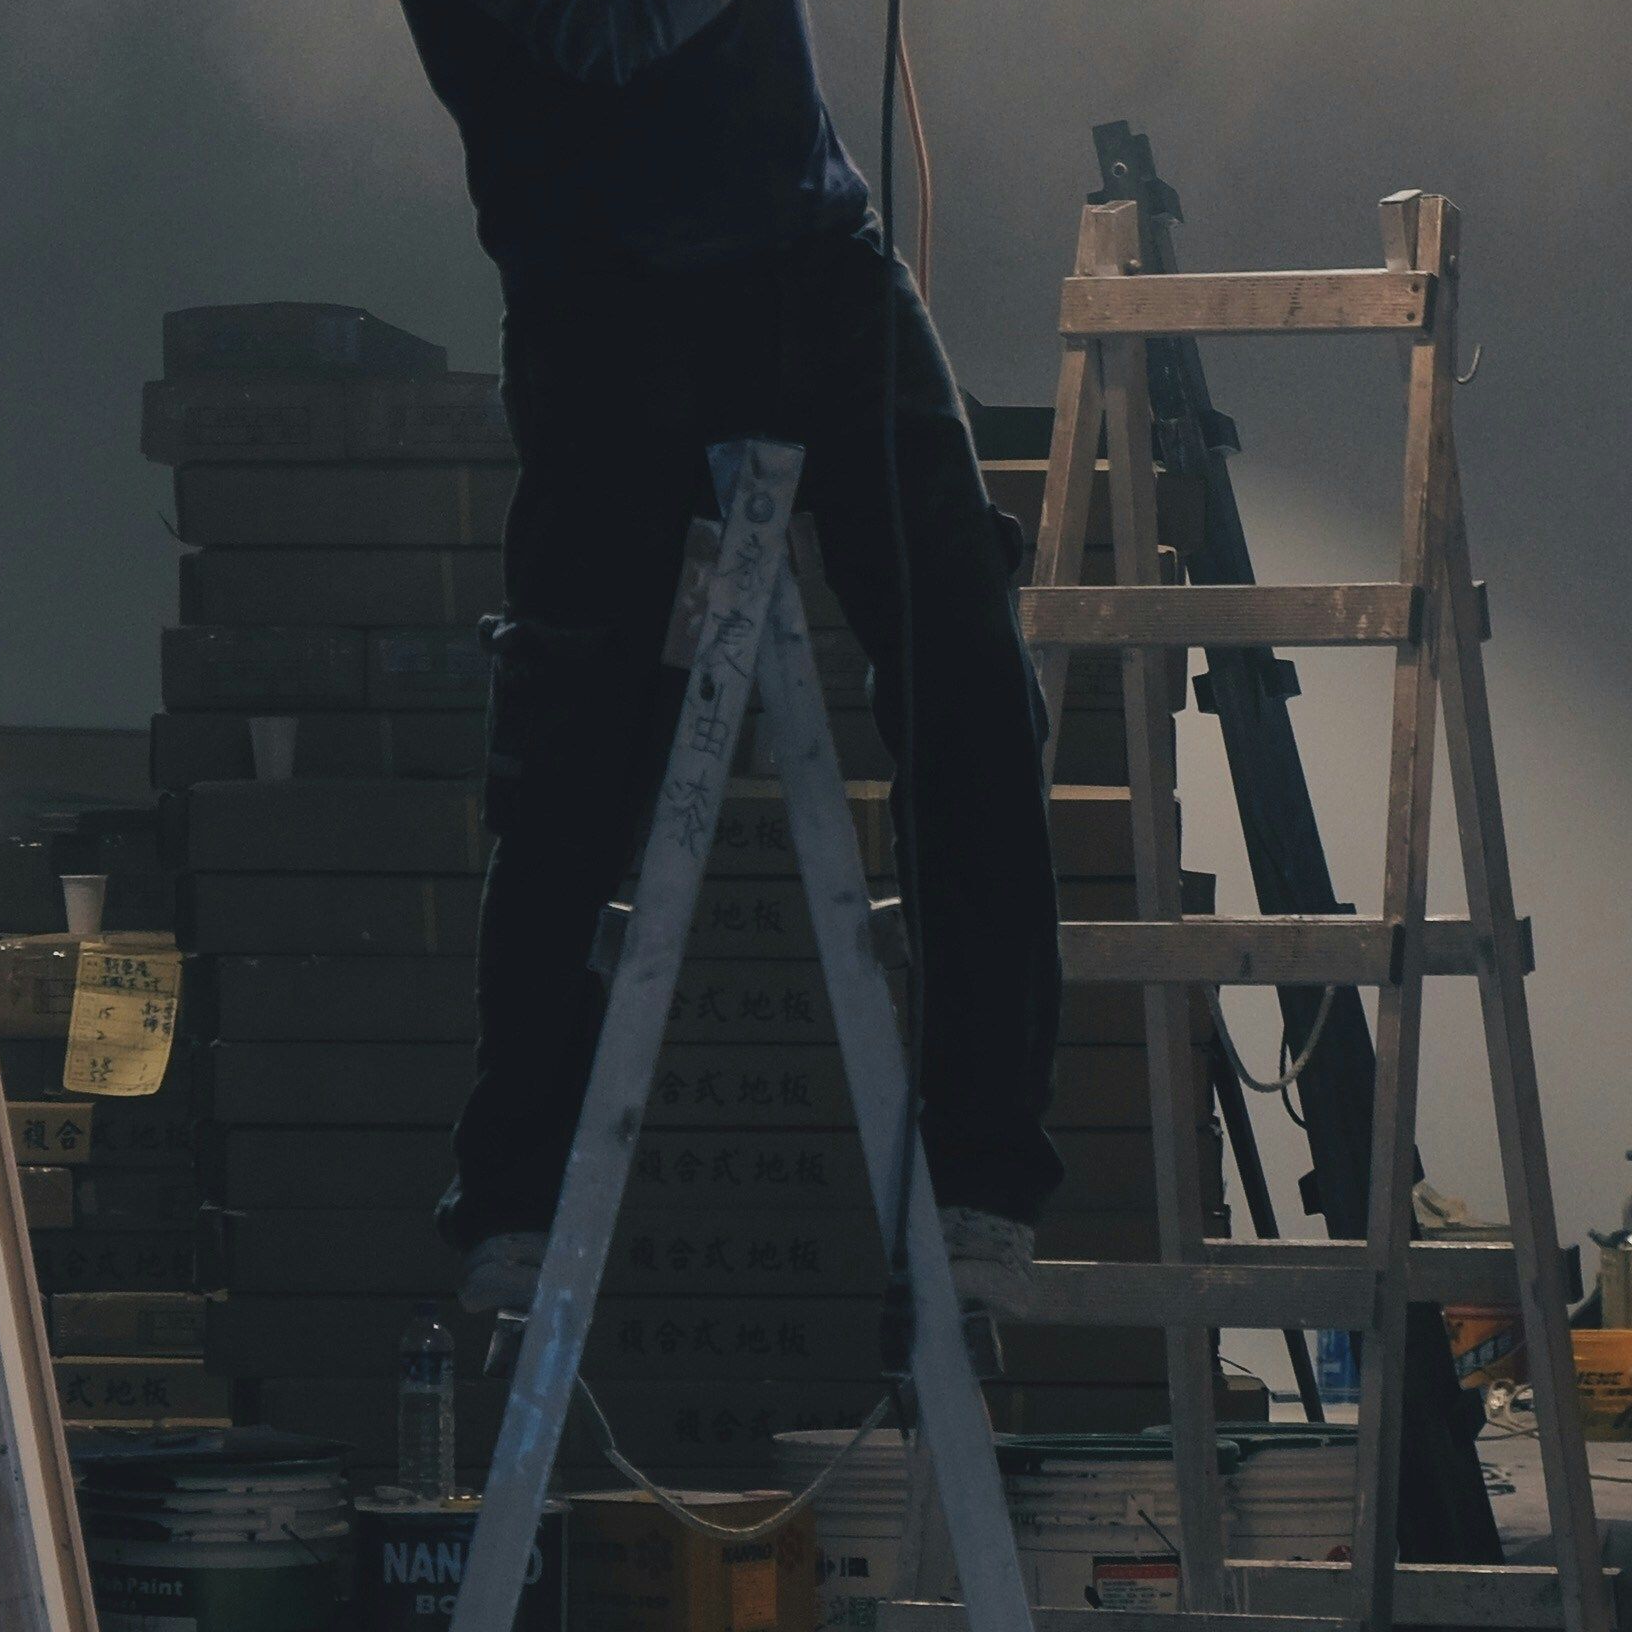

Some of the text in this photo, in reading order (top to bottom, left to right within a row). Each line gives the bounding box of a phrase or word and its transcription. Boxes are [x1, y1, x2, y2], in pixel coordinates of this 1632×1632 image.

[65, 1376, 172, 1410] 式地板
[382, 1541, 544, 1586] NANO
